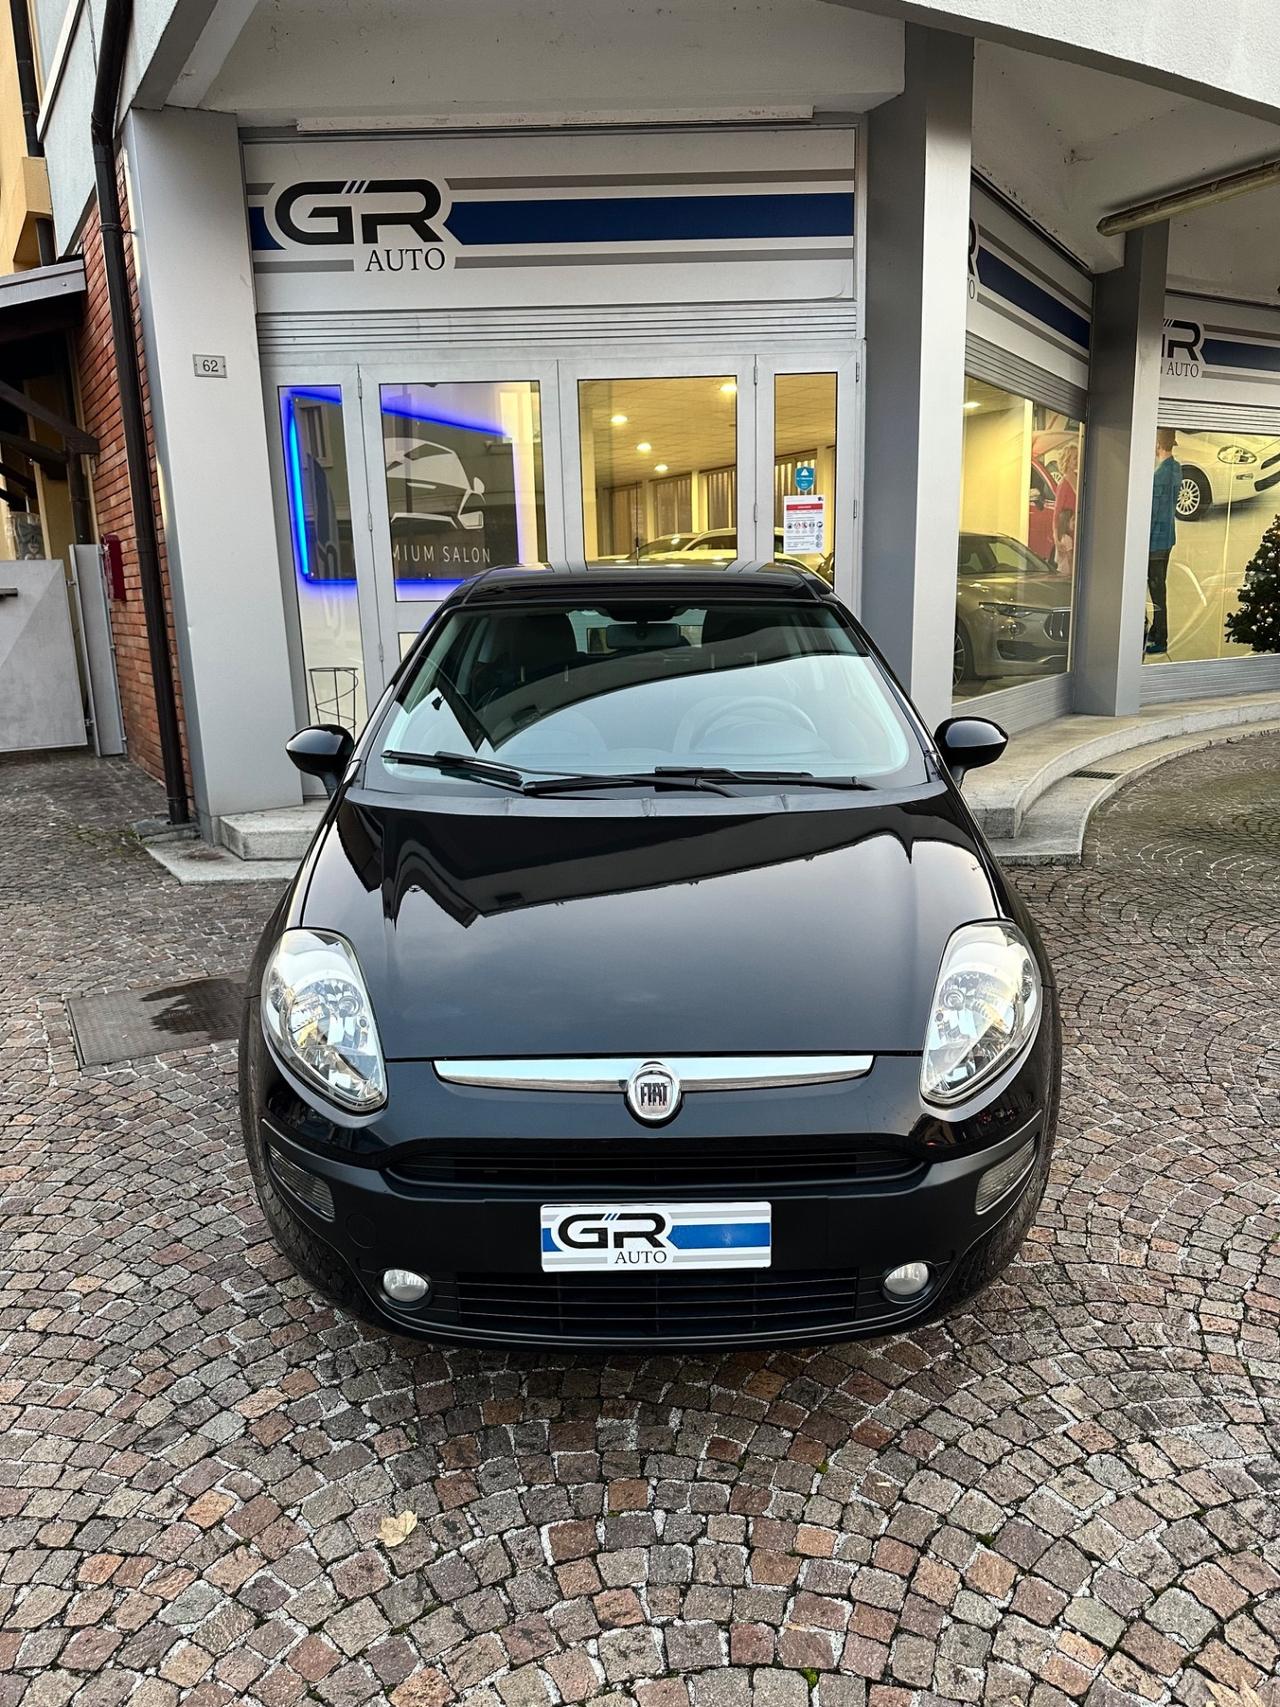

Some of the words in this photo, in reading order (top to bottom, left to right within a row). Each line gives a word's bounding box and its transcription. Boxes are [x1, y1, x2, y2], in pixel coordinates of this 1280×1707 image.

[275, 179, 444, 245] GR
[365, 248, 446, 272] AUTO
[1162, 318, 1200, 361] R
[202, 359, 219, 372] 62
[1166, 360, 1200, 378] AUTO
[442, 545, 491, 563] SALON
[640, 1082, 668, 1106] FIAT
[557, 1212, 666, 1249] GR
[615, 1251, 667, 1264] AUTO
